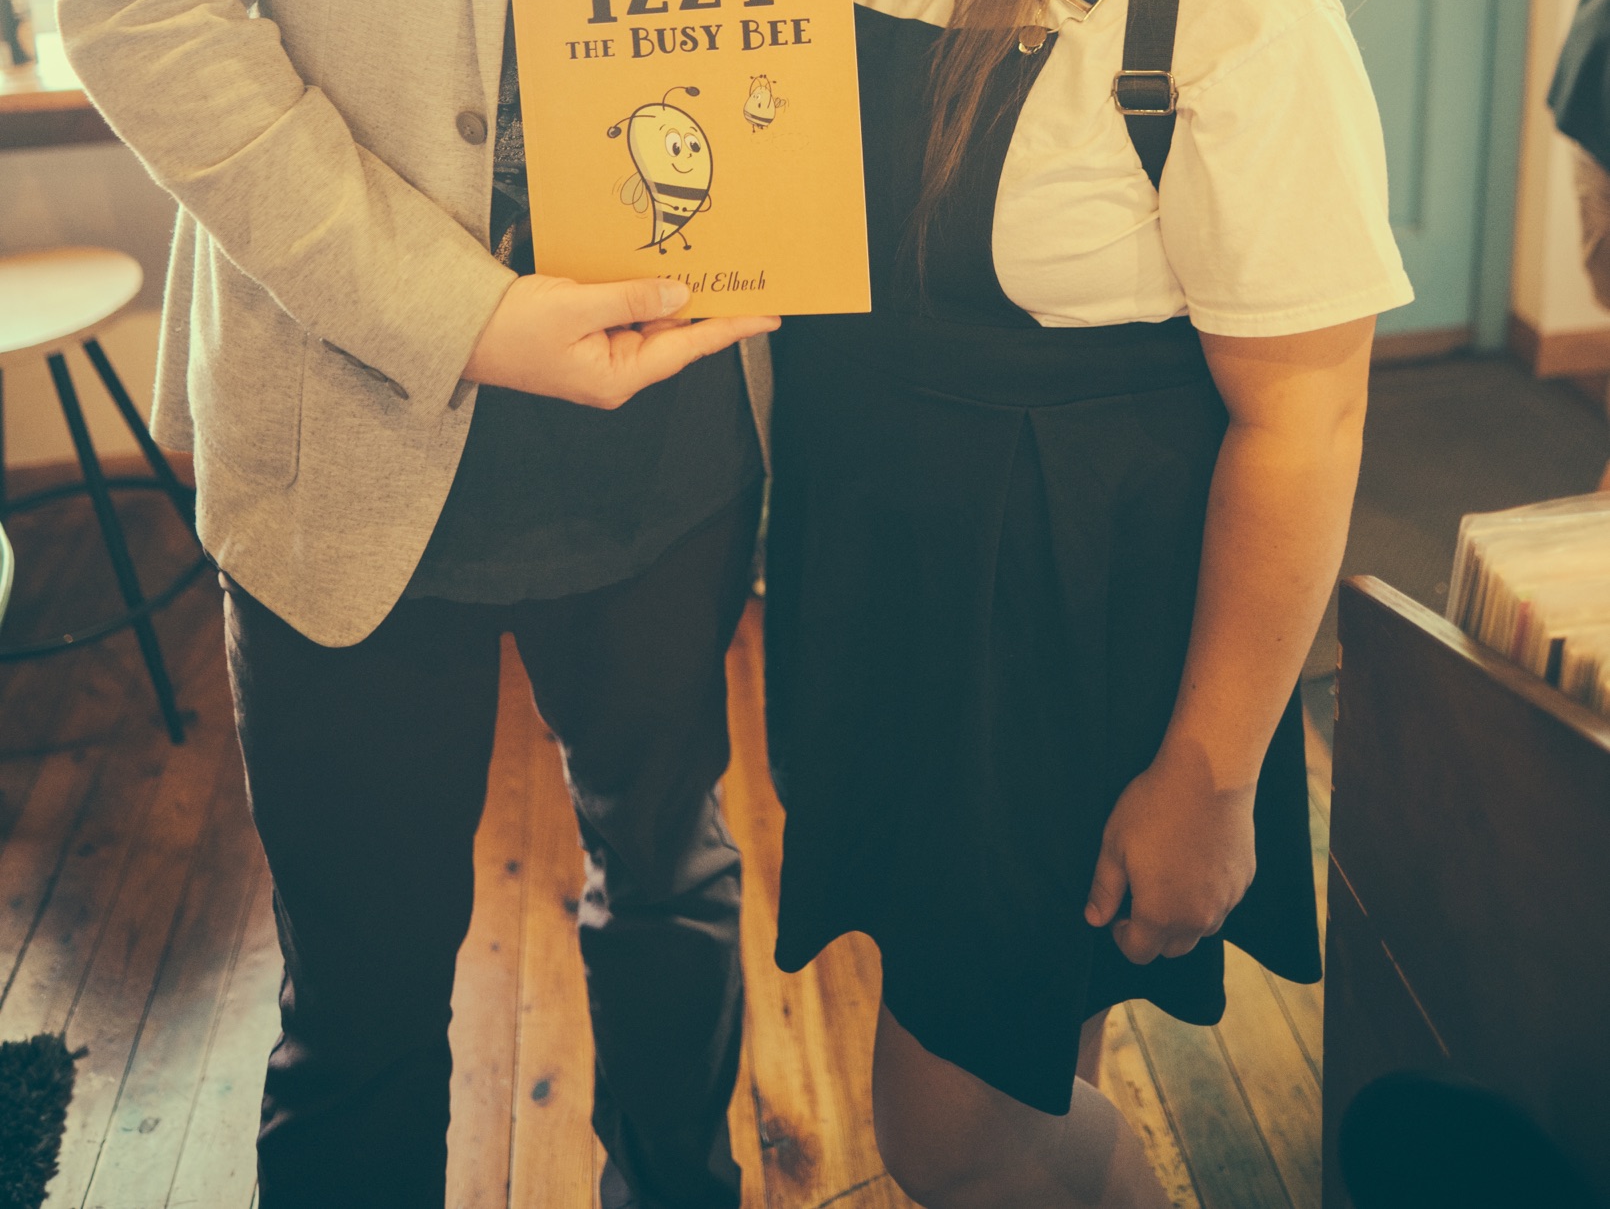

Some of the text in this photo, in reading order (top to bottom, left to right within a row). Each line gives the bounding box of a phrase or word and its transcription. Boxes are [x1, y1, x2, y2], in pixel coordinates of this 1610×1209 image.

[566, 18, 812, 60] THE BUSY BEE
[710, 270, 766, 292] Elbech
